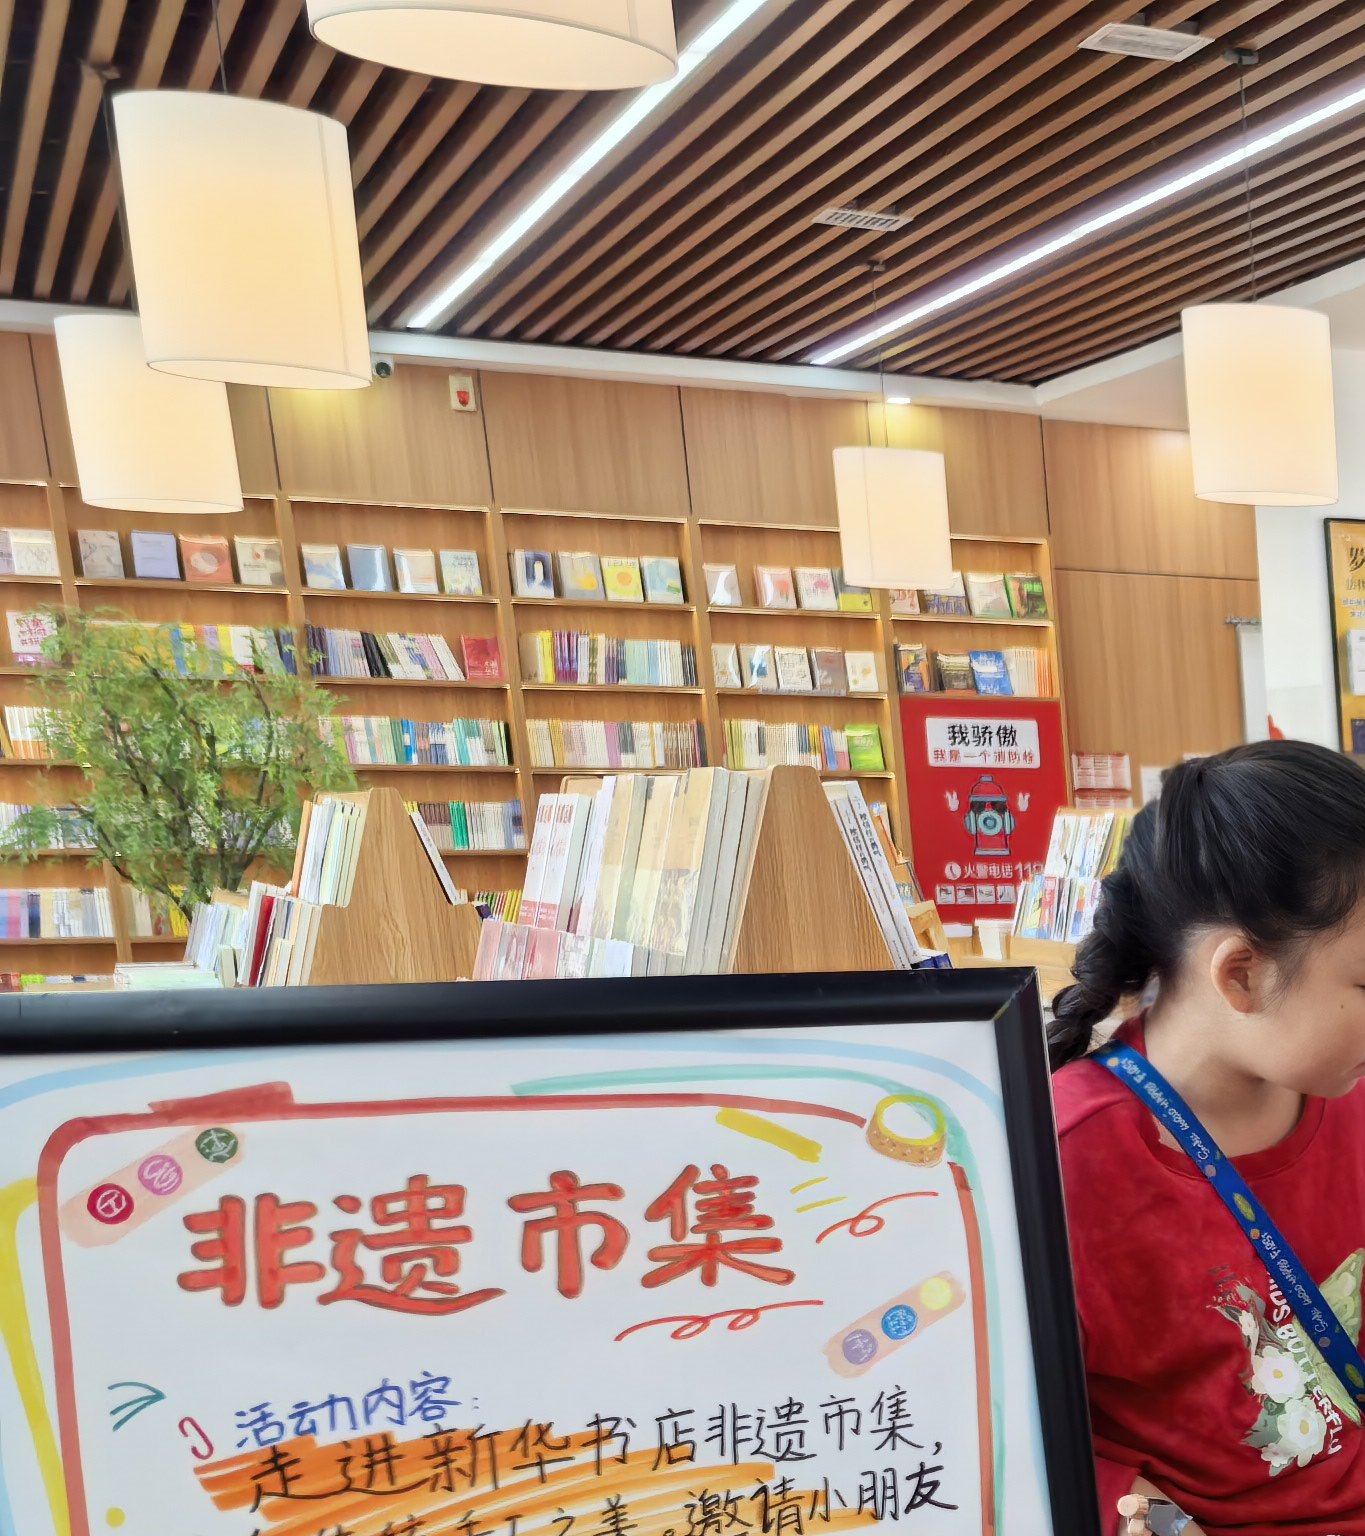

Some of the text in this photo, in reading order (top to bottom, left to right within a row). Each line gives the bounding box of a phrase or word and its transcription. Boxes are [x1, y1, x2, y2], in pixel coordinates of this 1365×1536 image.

[947, 724, 1018, 747] 我骄傲
[933, 748, 1034, 765] 我是一个消防栓
[175, 1162, 797, 1316] 非遗市集
